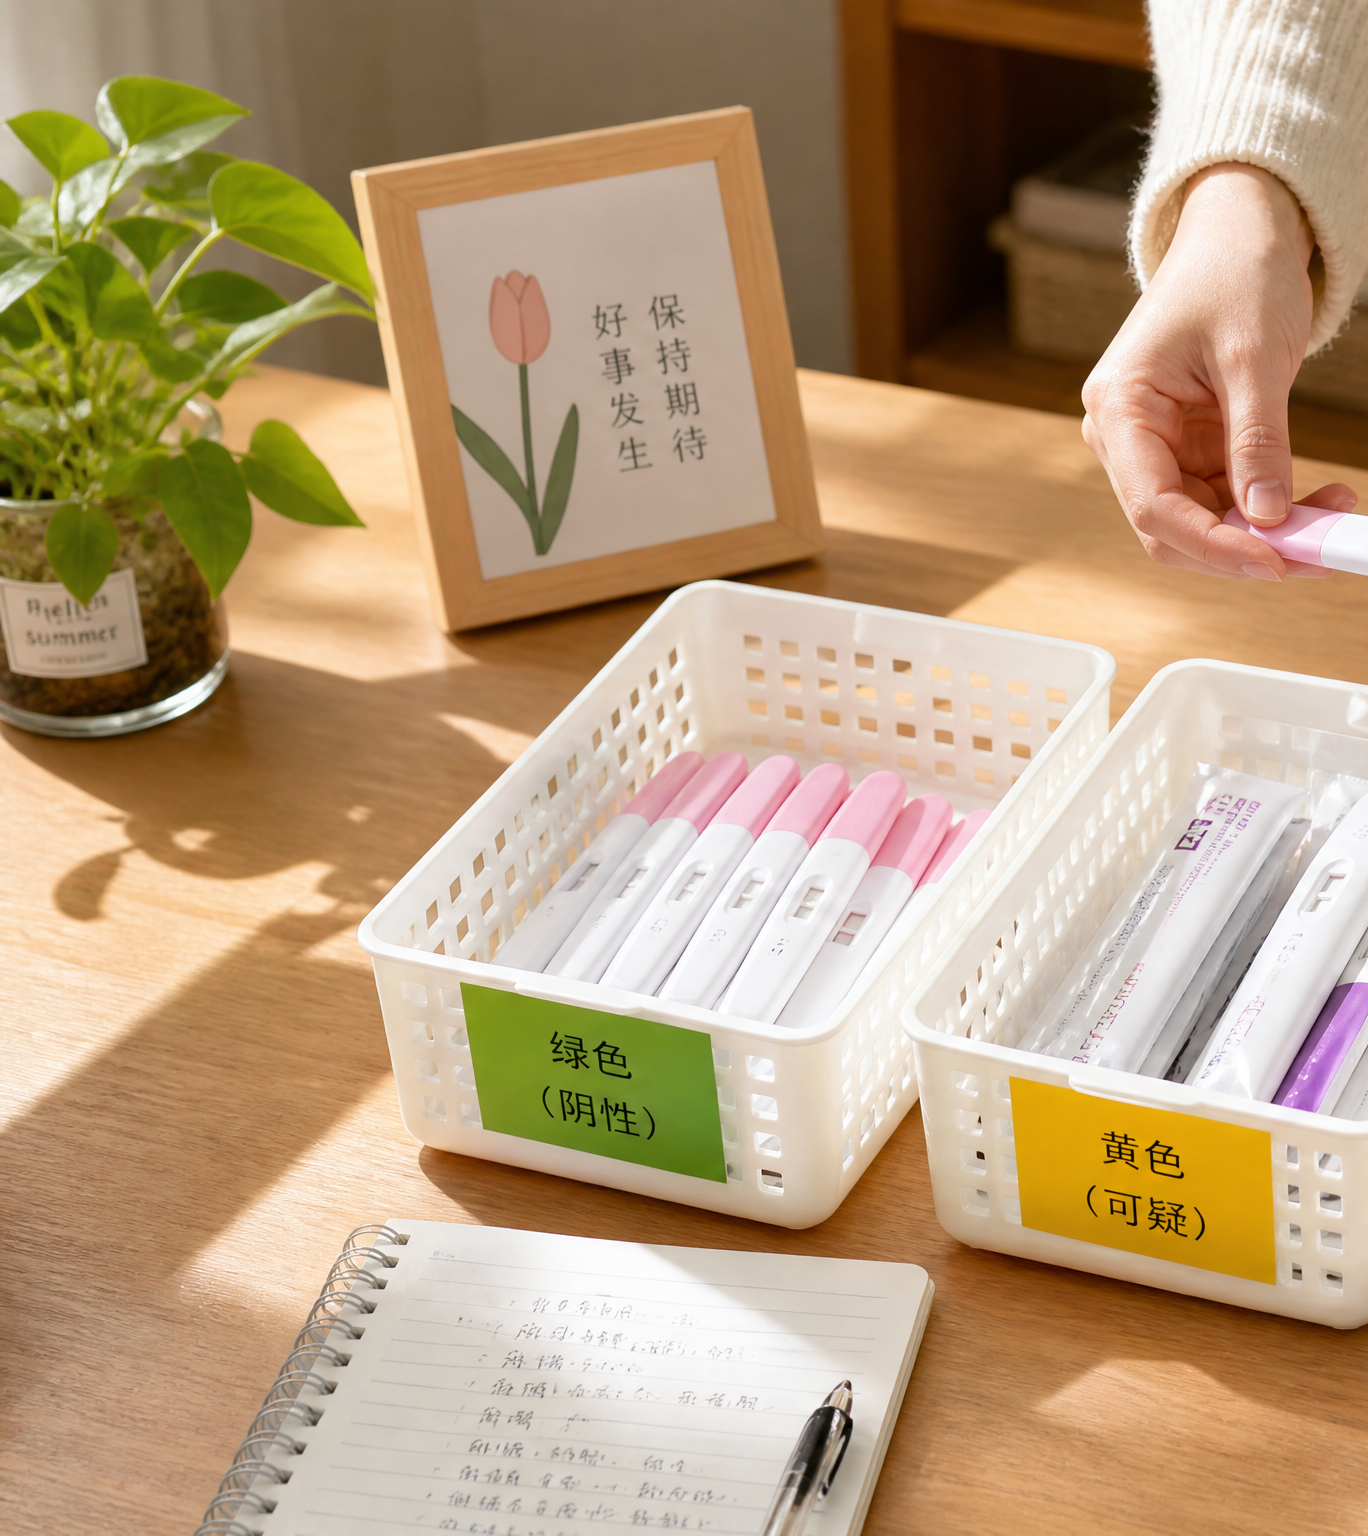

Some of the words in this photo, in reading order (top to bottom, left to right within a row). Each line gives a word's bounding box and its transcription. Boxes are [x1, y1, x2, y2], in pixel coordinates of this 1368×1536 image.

[592, 303, 654, 473] 好事发生
[648, 294, 708, 464] 保持期待
[550, 1030, 633, 1080] 绿色
[542, 1085, 656, 1141] （阴性）
[1100, 1131, 1185, 1180] 黄色
[1086, 1184, 1206, 1242] （可疑）
